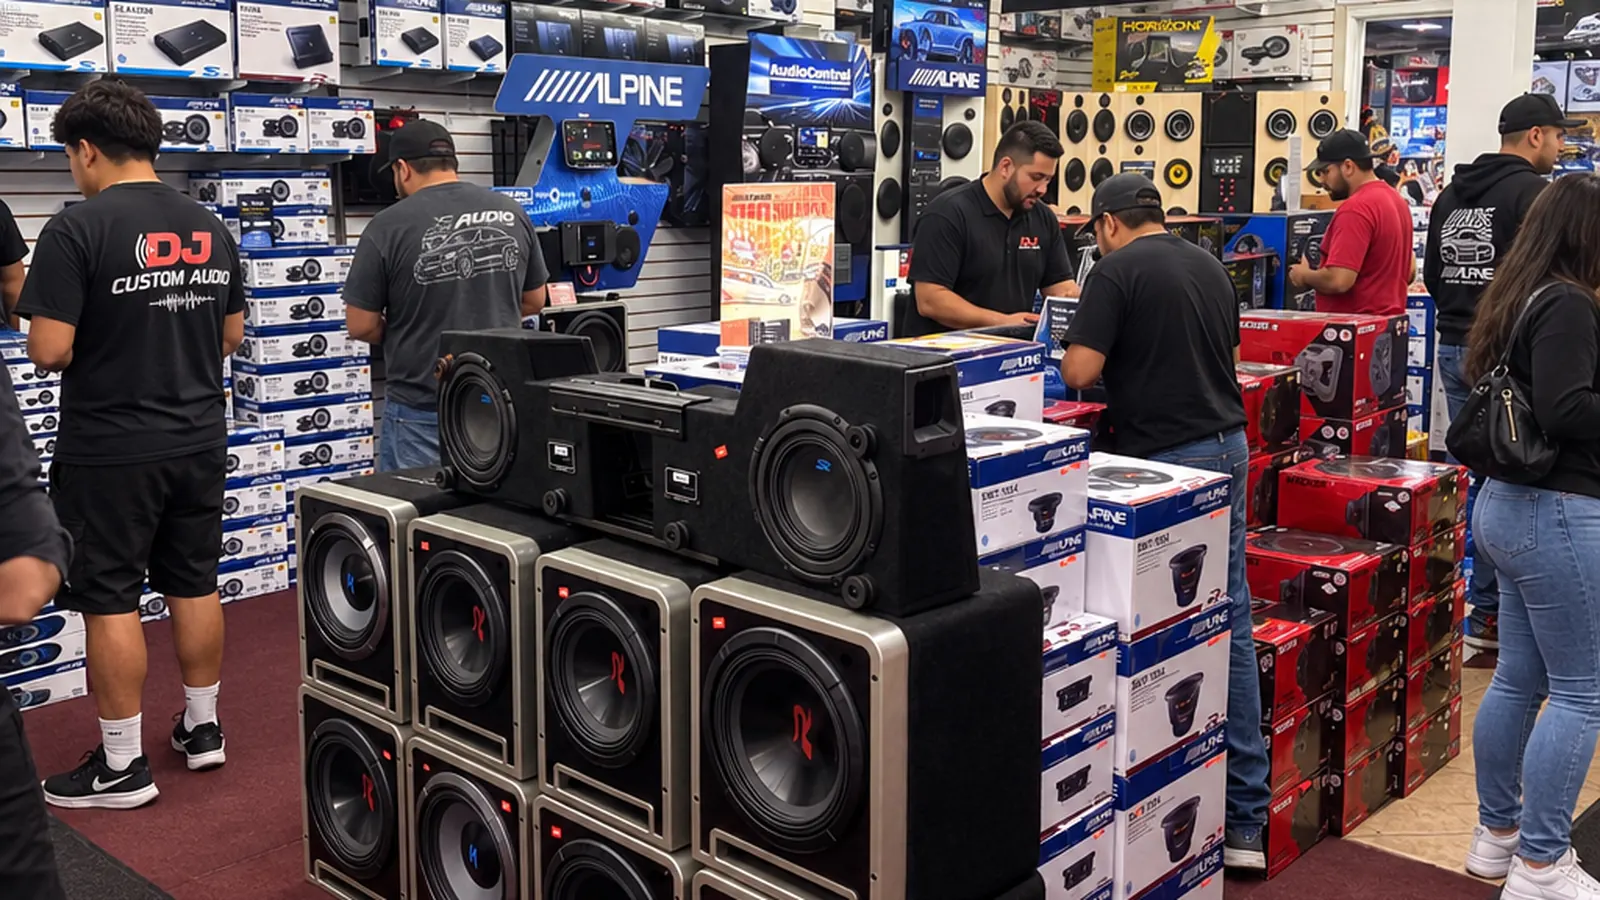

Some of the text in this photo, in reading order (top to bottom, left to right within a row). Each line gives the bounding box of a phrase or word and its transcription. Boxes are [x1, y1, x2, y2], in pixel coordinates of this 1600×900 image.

[524, 69, 683, 107] ALPINE
[909, 68, 981, 89] ALPINE
[454, 210, 515, 229] AUDIO
[145, 231, 212, 268] DJ
[111, 269, 185, 295] CUSTOM
